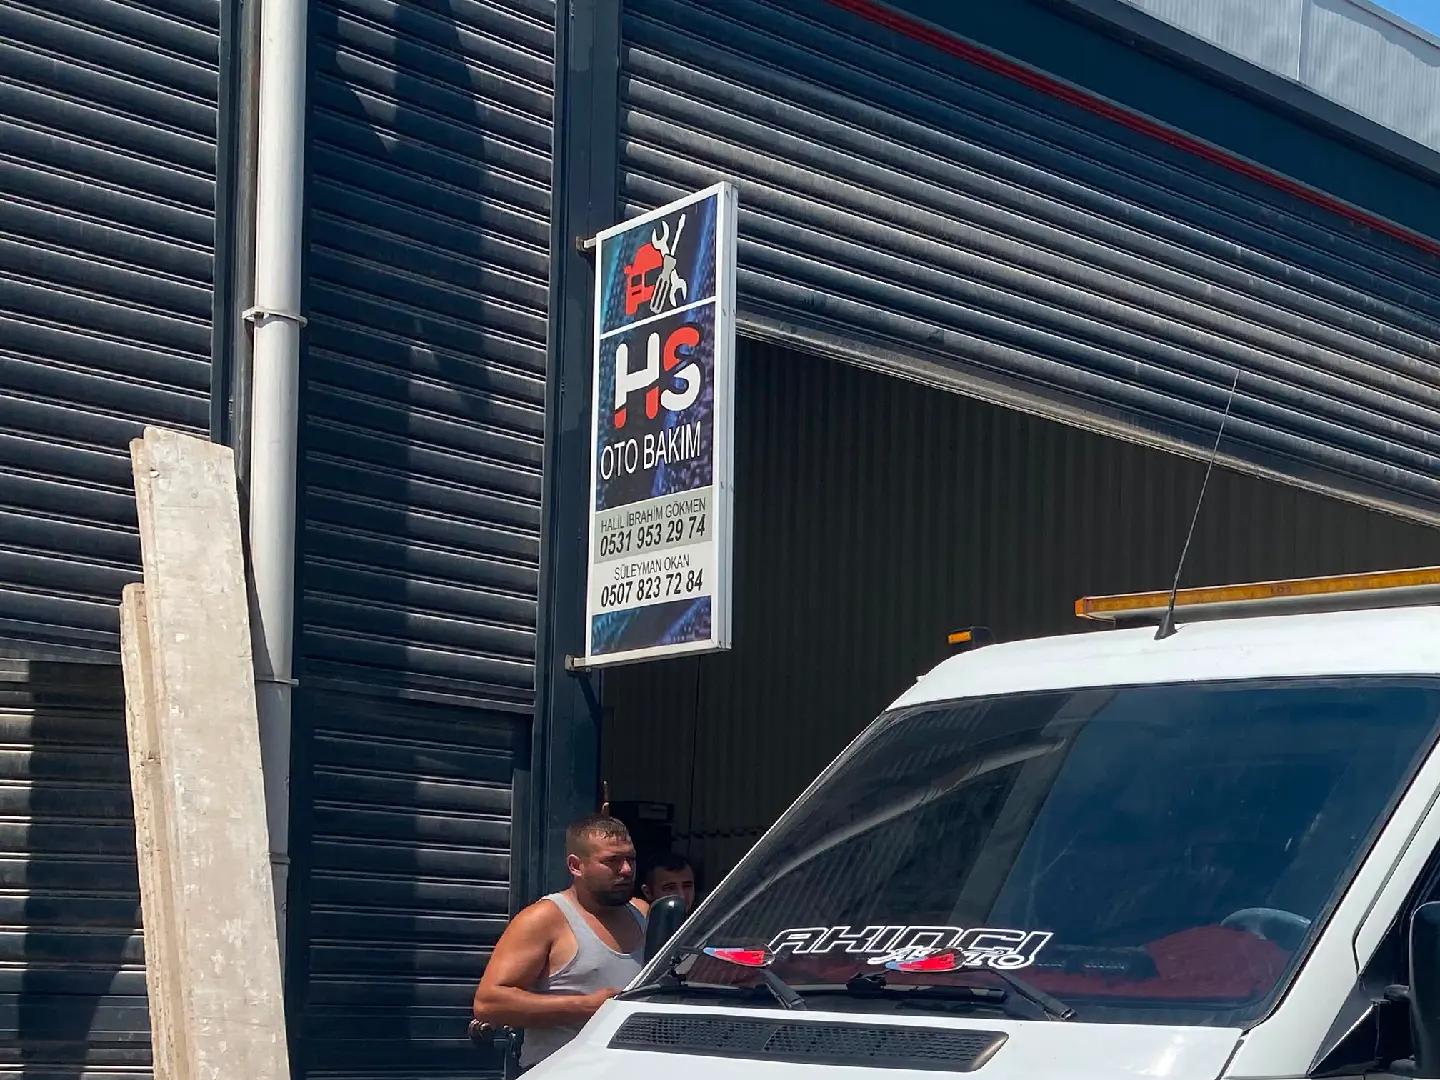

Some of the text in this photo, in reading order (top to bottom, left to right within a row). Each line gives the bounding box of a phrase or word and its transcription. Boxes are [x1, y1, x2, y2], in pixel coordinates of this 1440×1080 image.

[614, 326, 701, 429] HS
[600, 420, 701, 480] OTO BAKIM
[665, 497, 706, 519] GÖKMEN
[600, 513, 706, 557] 0531 953 29 74
[601, 568, 703, 608] 0507 823 72 84
[614, 553, 690, 581] SÜLEYMAN OKAN
